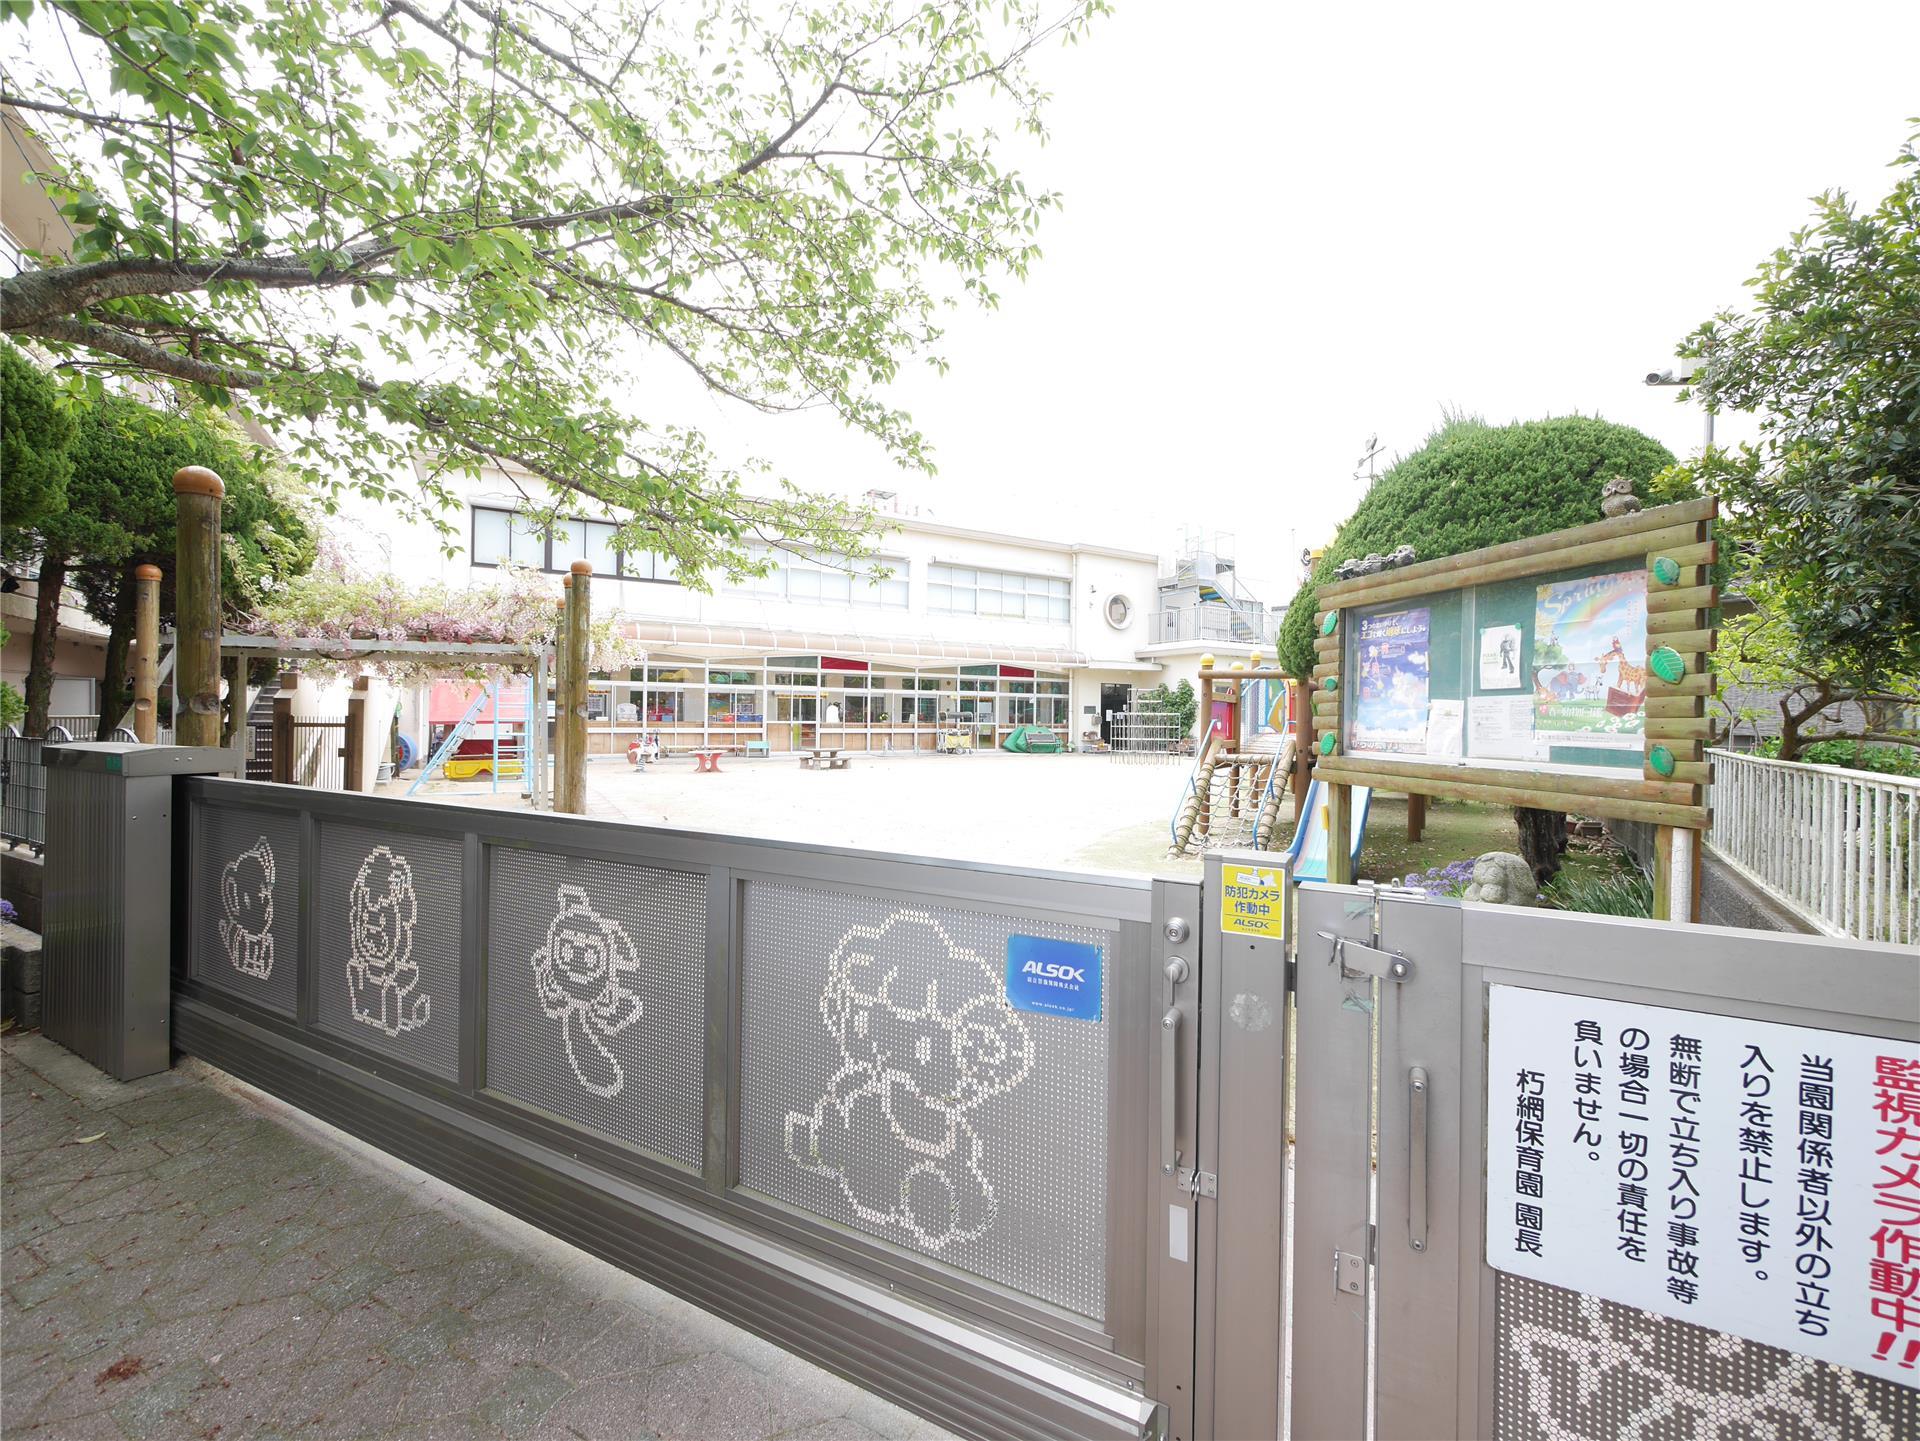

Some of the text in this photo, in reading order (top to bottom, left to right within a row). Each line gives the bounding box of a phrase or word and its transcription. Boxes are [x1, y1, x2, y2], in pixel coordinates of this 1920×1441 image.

[1022, 960, 1086, 984] ALSOK
[1224, 885, 1281, 902] 防犯カメラ
[1233, 918, 1270, 930] ALSOK
[1234, 900, 1270, 916] 作動中
[1515, 1068, 1546, 1258] 朽網保育園 園長
[1573, 1019, 1603, 1163] 負いません。
[1617, 1027, 1650, 1263] の場合一切の責任を
[1667, 1033, 1703, 1305] 無断で立ち入り事故等
[1738, 1045, 1775, 1281] 入りを禁止します。
[1795, 1053, 1834, 1337] 当園関係者以外の立ち
